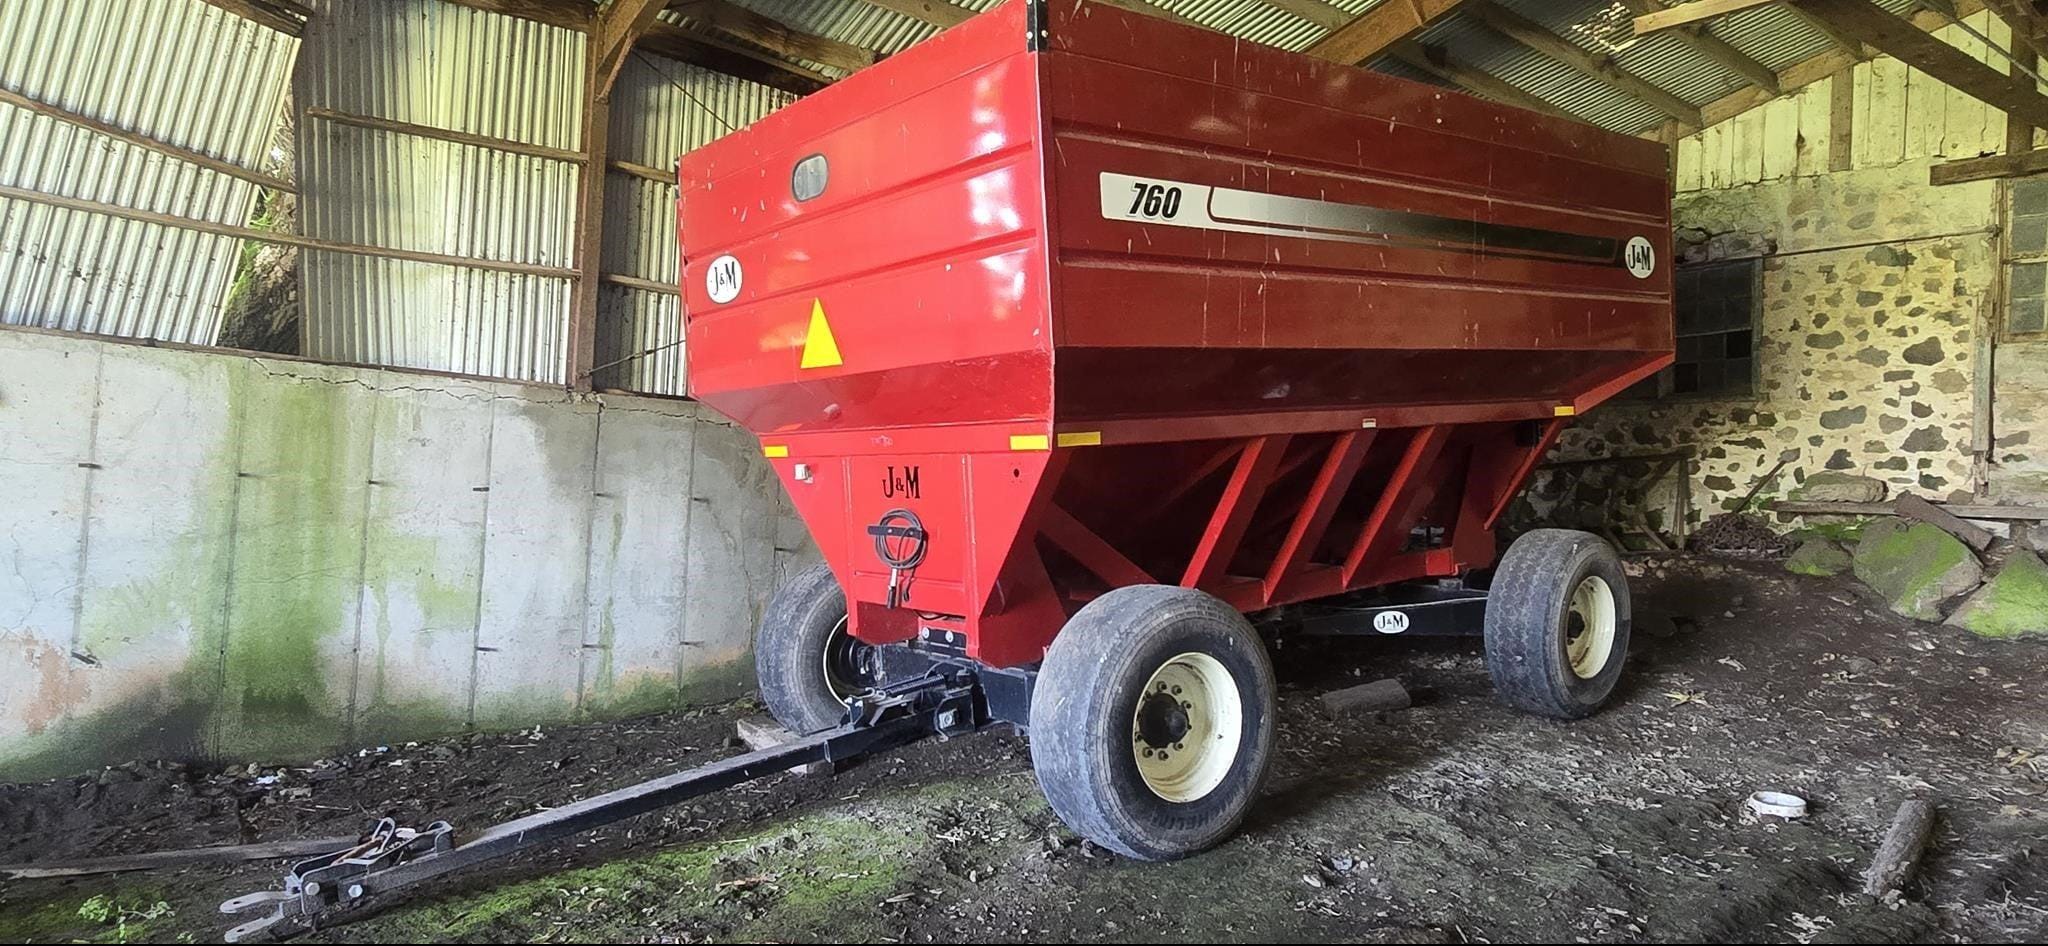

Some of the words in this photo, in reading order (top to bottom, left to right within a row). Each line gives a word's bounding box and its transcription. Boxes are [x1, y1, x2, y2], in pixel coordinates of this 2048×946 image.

[1129, 182, 1182, 219] 760
[1628, 245, 1651, 270] J&M
[711, 261, 737, 295] J&M
[882, 466, 920, 499] J&M
[1377, 614, 1404, 629] J&M
